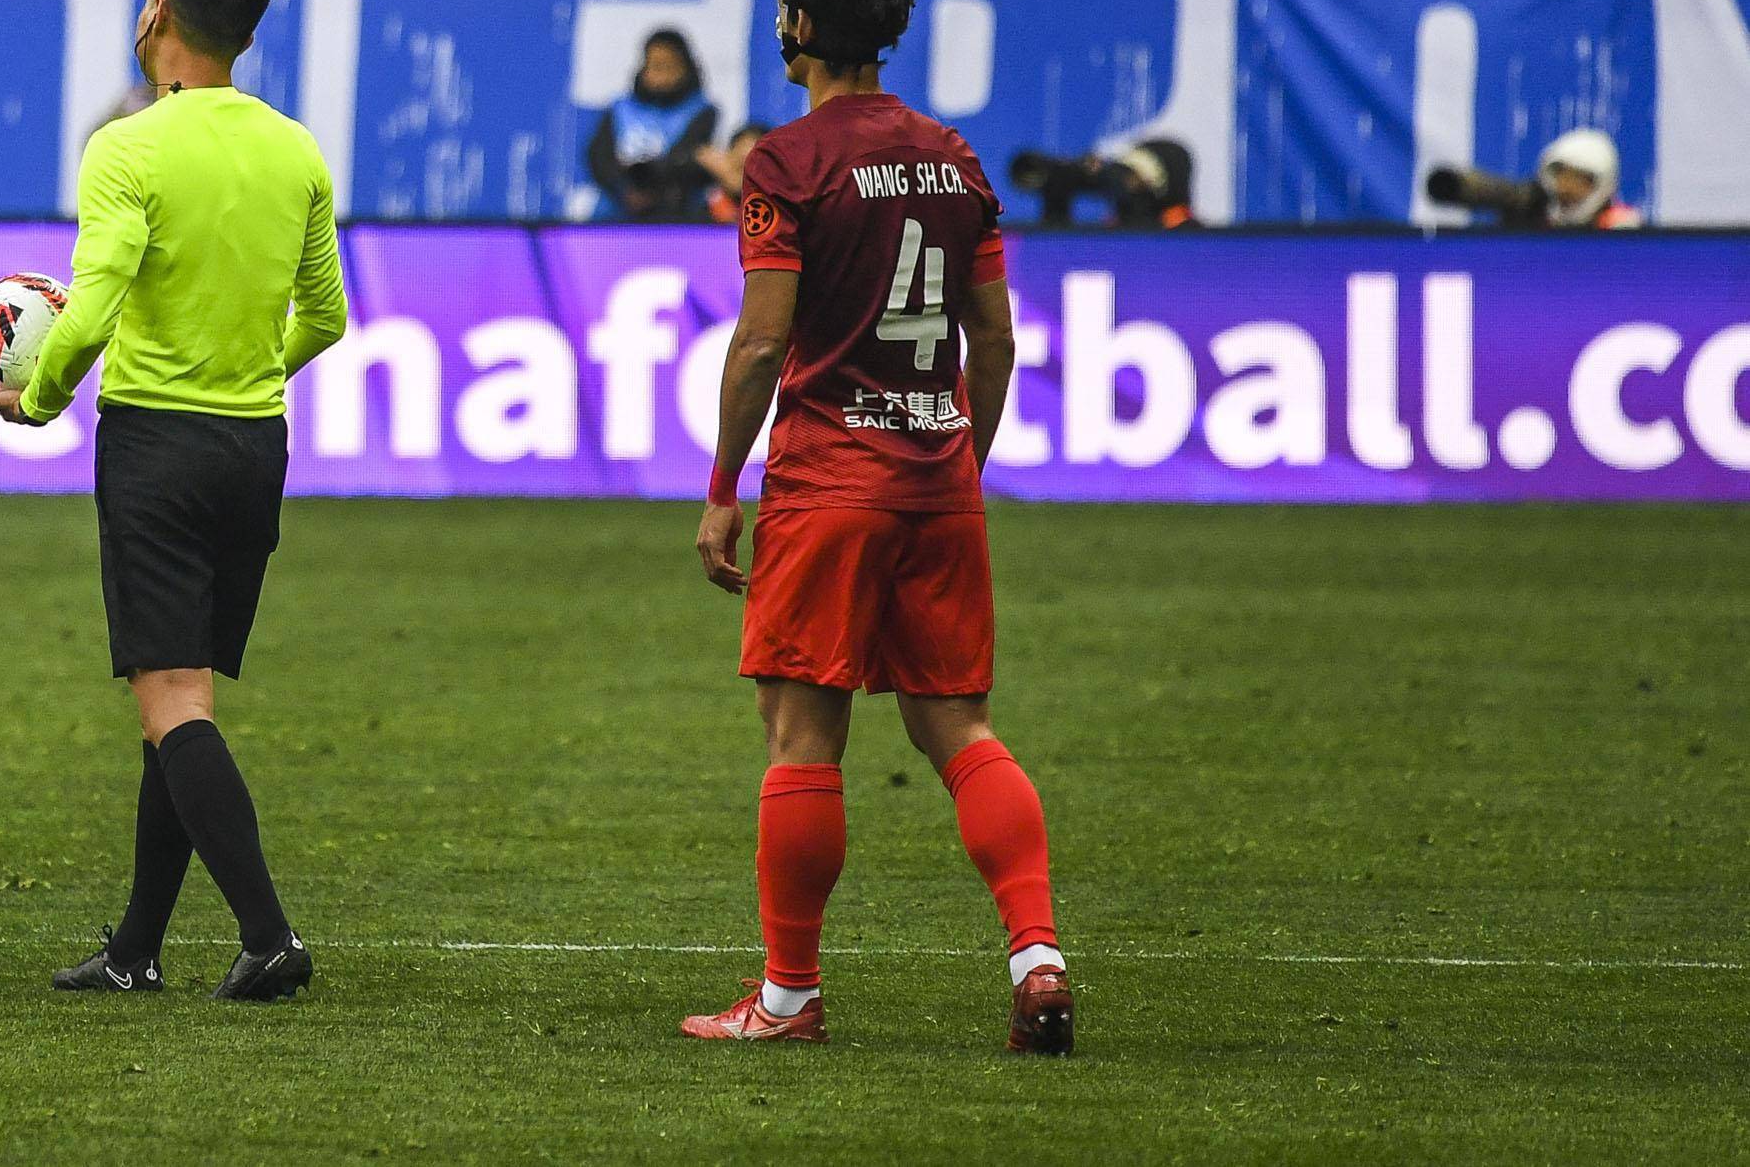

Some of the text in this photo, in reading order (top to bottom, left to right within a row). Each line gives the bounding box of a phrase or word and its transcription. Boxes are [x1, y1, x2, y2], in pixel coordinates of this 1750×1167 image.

[852, 163, 968, 198] WANG SH.CH.
[876, 218, 948, 370] 4
[844, 415, 900, 430] SAIC
